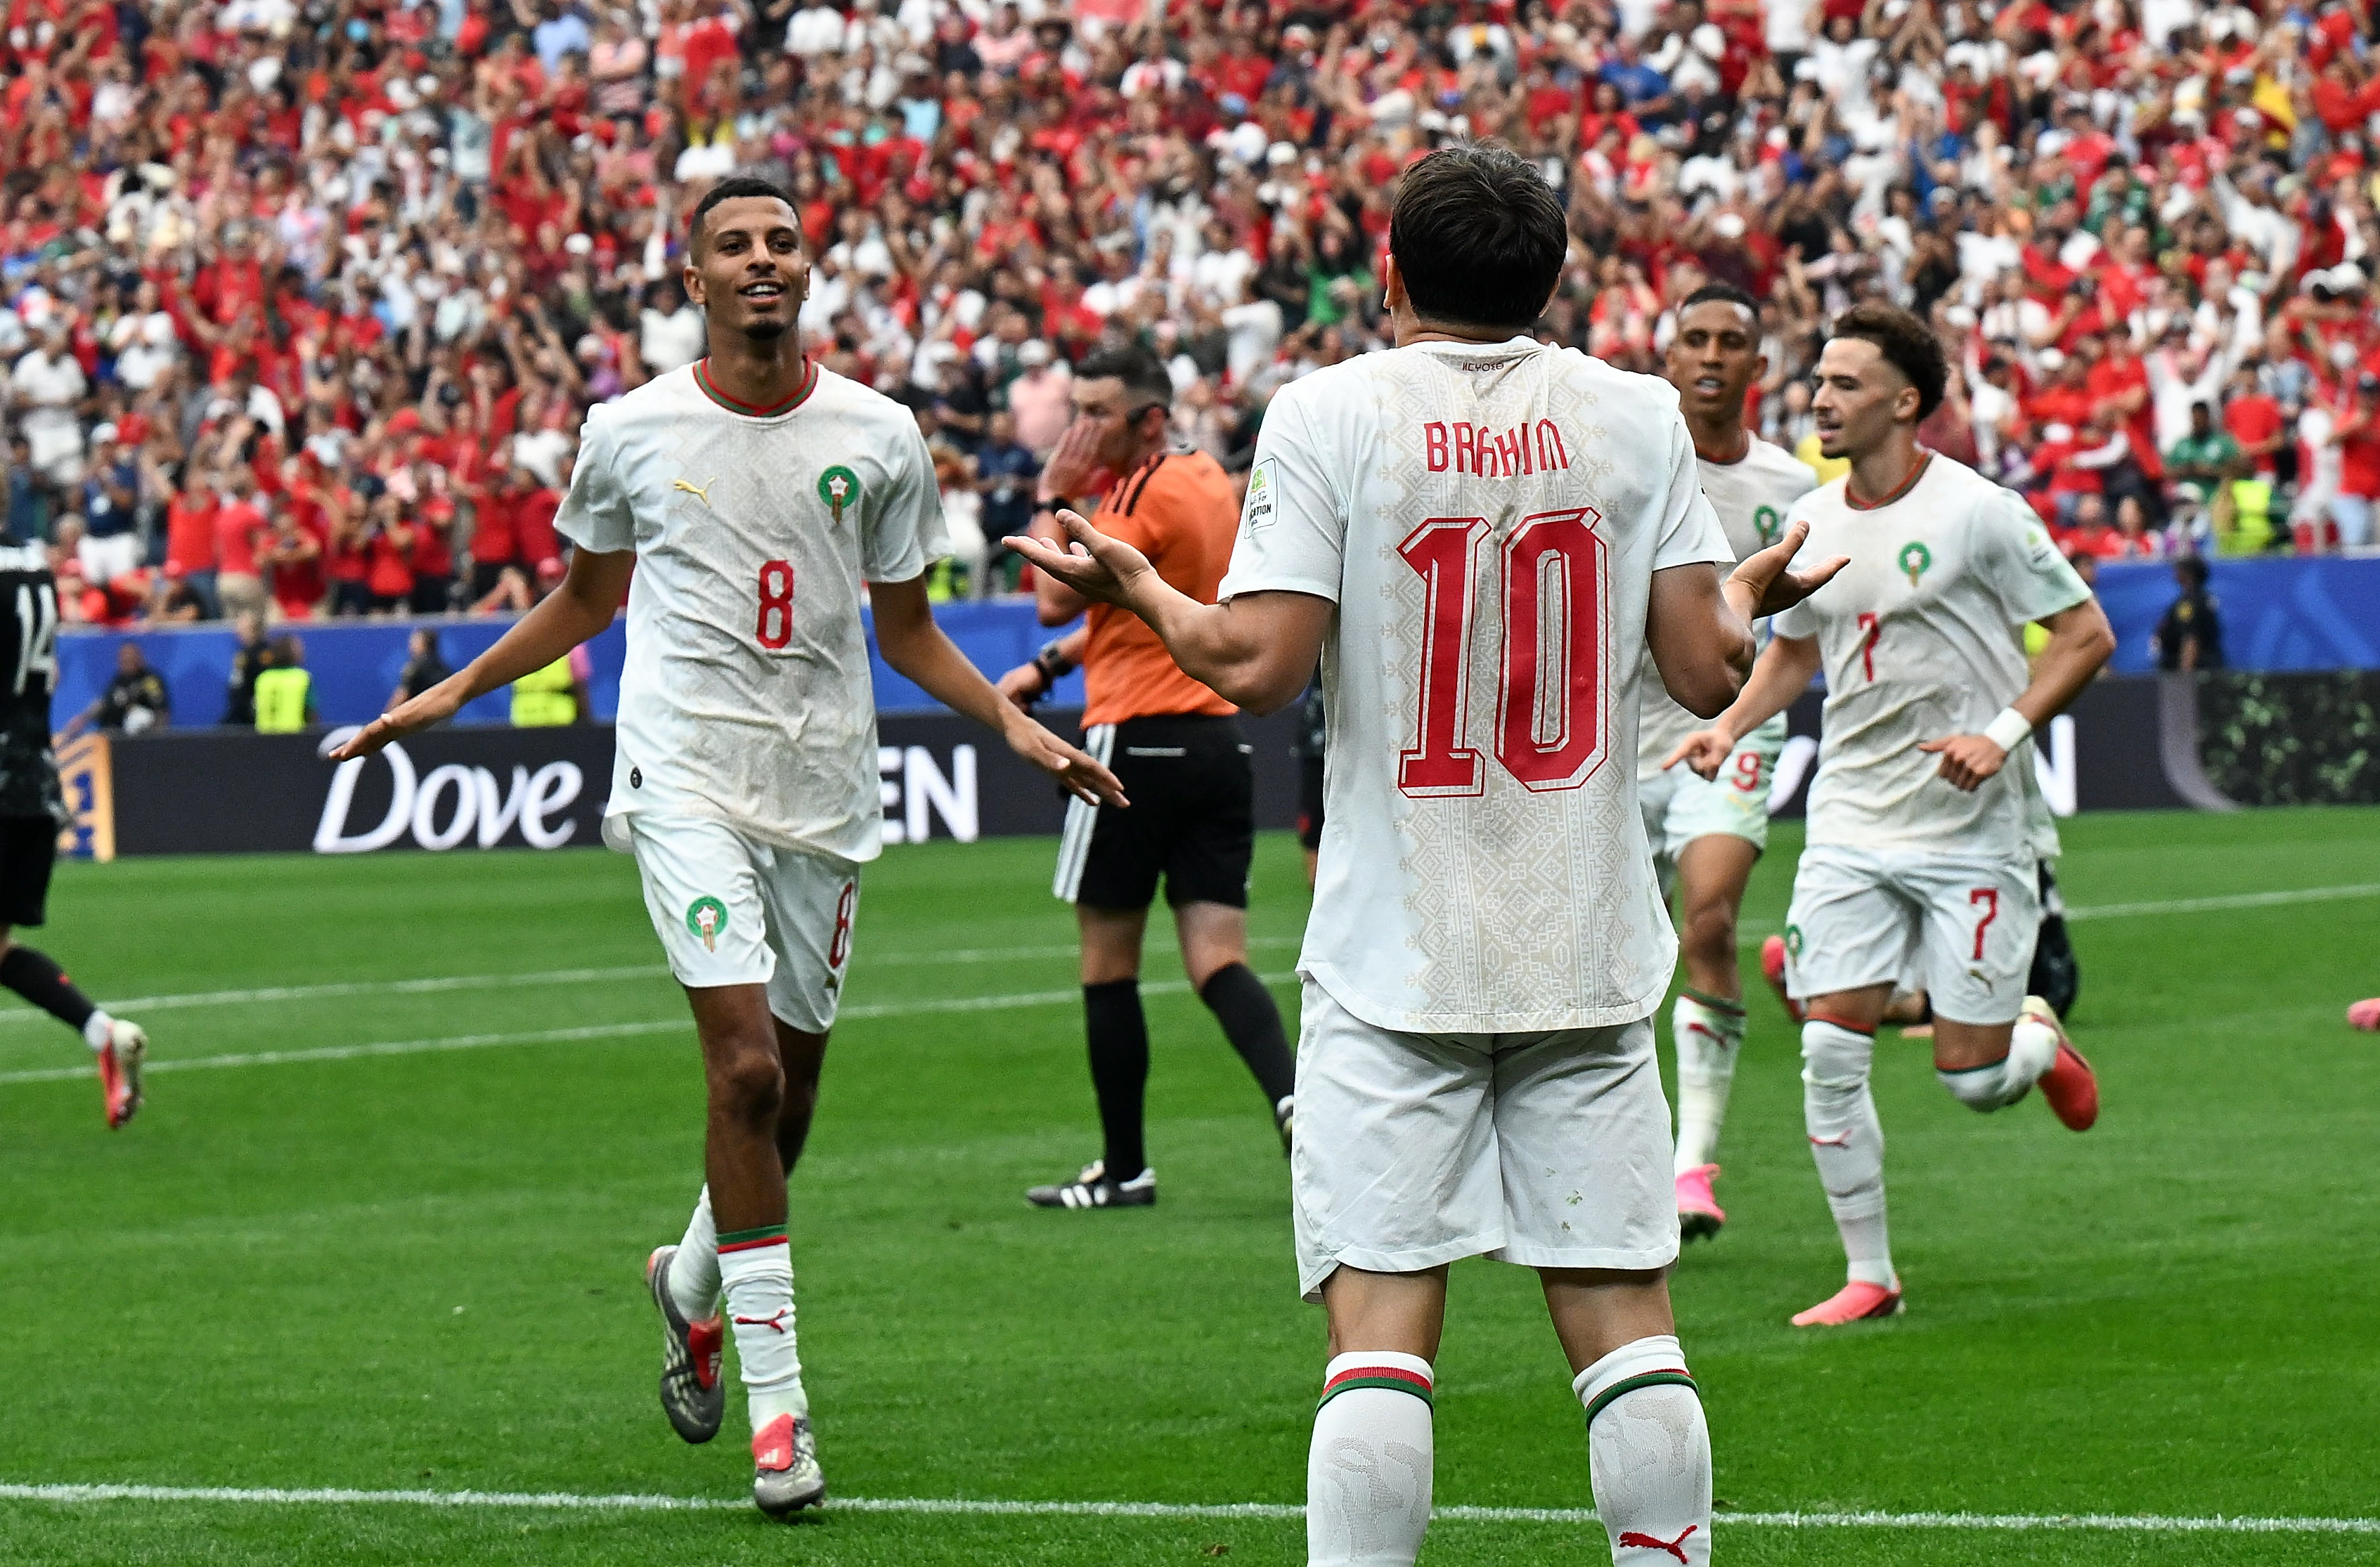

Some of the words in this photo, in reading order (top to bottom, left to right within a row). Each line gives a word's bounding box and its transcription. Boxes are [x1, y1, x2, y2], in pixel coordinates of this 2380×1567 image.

[1423, 418, 1569, 478] BRAHIM
[13, 583, 59, 695] 14
[756, 559, 794, 649] 8
[1858, 611, 1882, 682] 7
[1396, 507, 1609, 799] 10
[311, 725, 584, 854] Dove
[1731, 751, 1761, 792] 9
[829, 880, 853, 970] 8
[1970, 887, 1998, 961] 7
